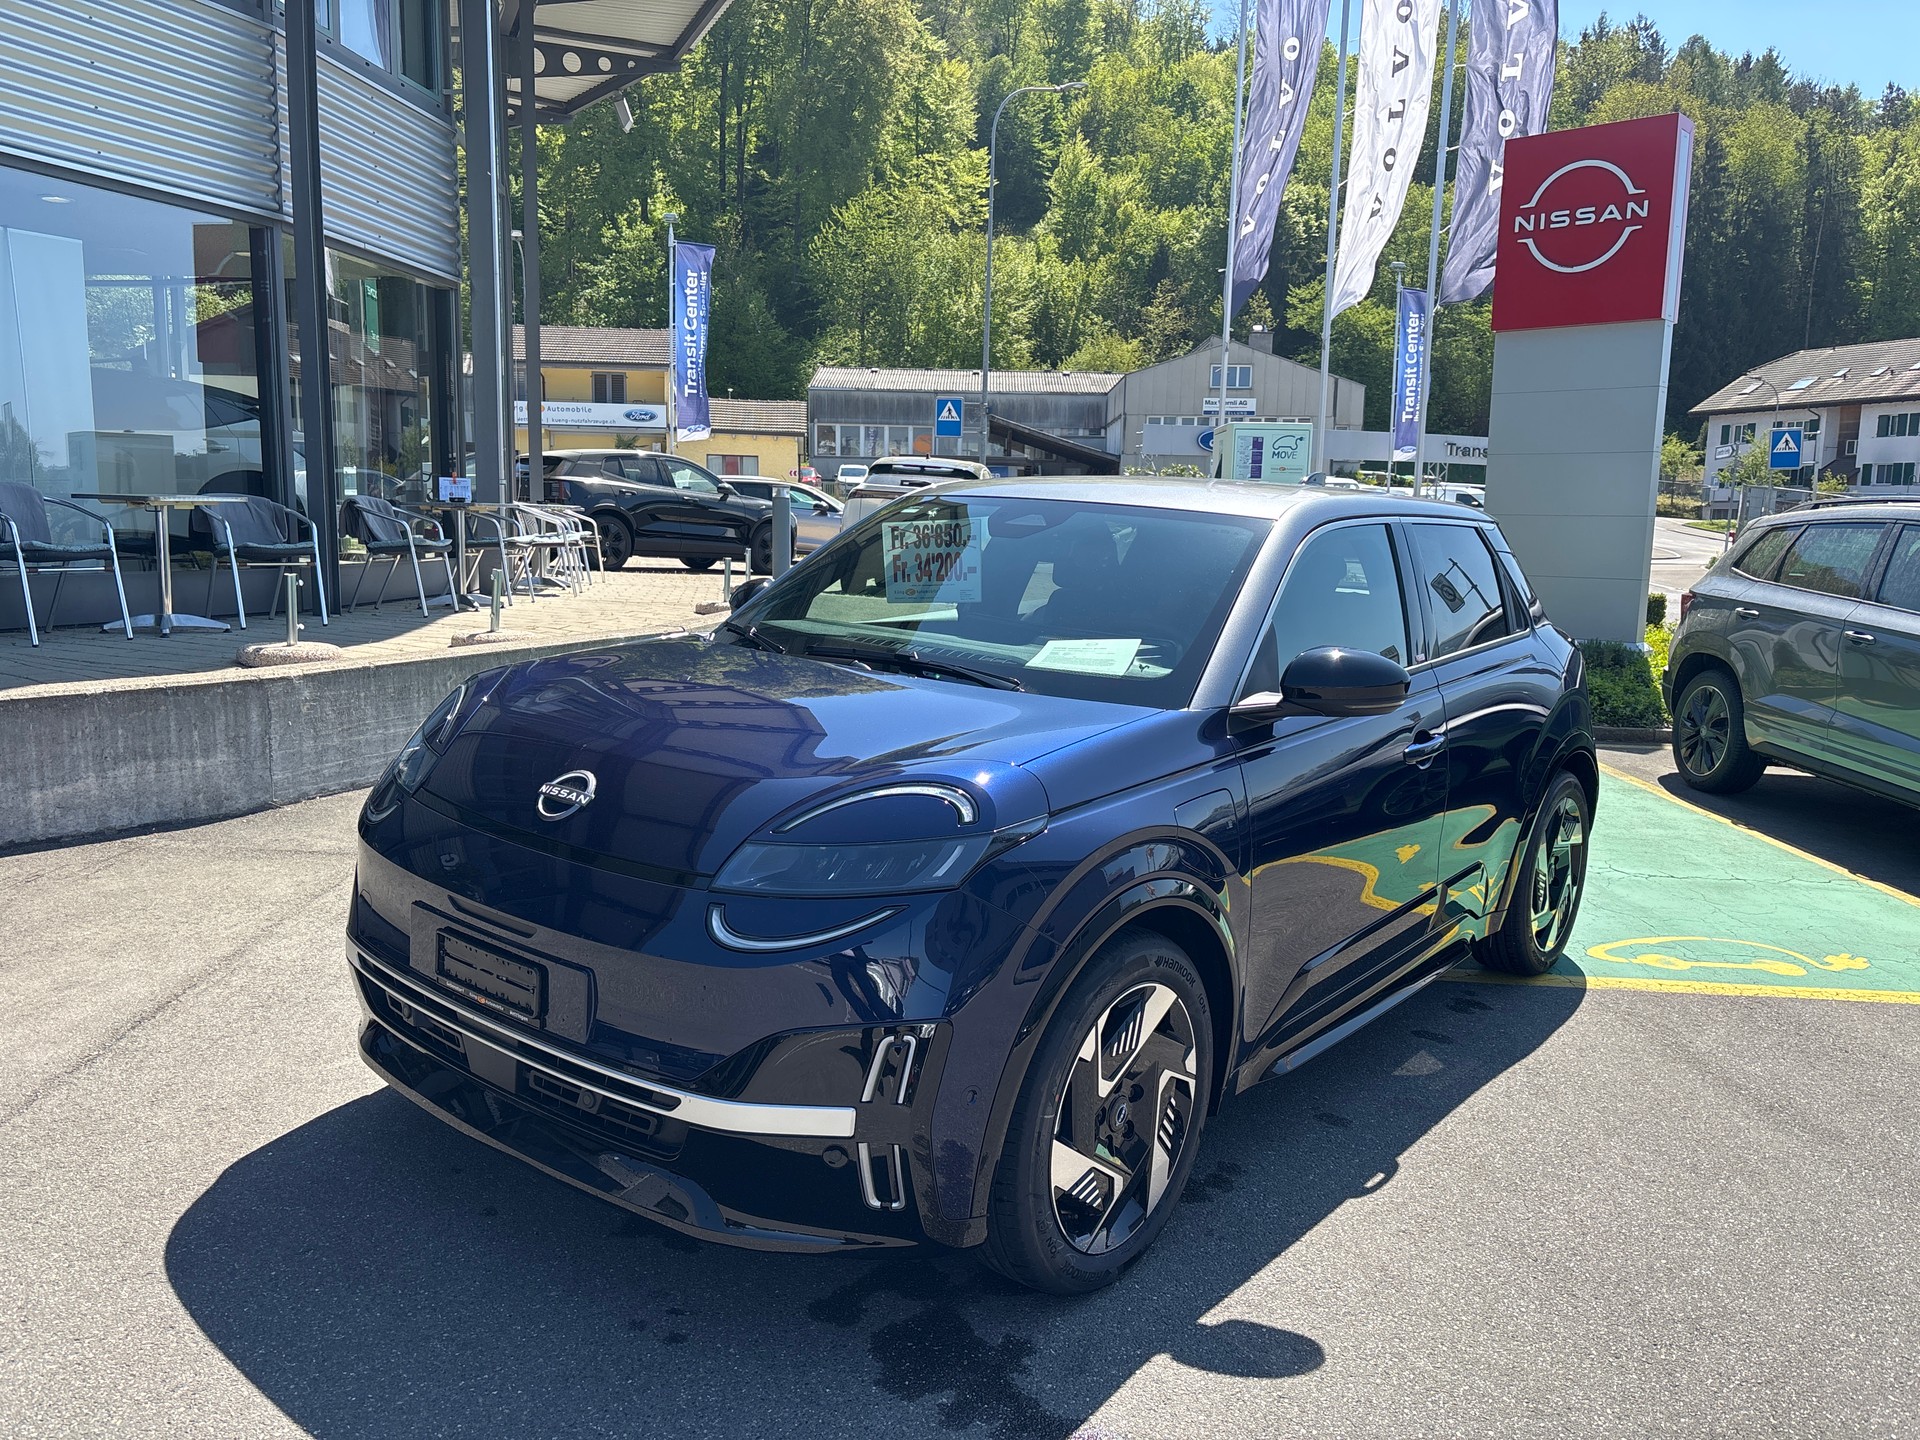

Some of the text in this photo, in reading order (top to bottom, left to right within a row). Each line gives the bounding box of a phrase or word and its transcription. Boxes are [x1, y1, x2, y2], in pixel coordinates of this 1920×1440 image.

[1367, 0, 1413, 223] VOLVO
[1240, 36, 1300, 240] VOLVO
[1514, 199, 1649, 233] NISSAN
[683, 269, 698, 397] Transit Center
[1405, 311, 1420, 365] Center
[546, 405, 593, 413] Automobile
[1401, 367, 1417, 423] Transit
[1271, 450, 1298, 459] MOVE
[890, 525, 909, 550] Fr.
[892, 554, 911, 583] Fr.
[538, 784, 590, 804] NISSAN
